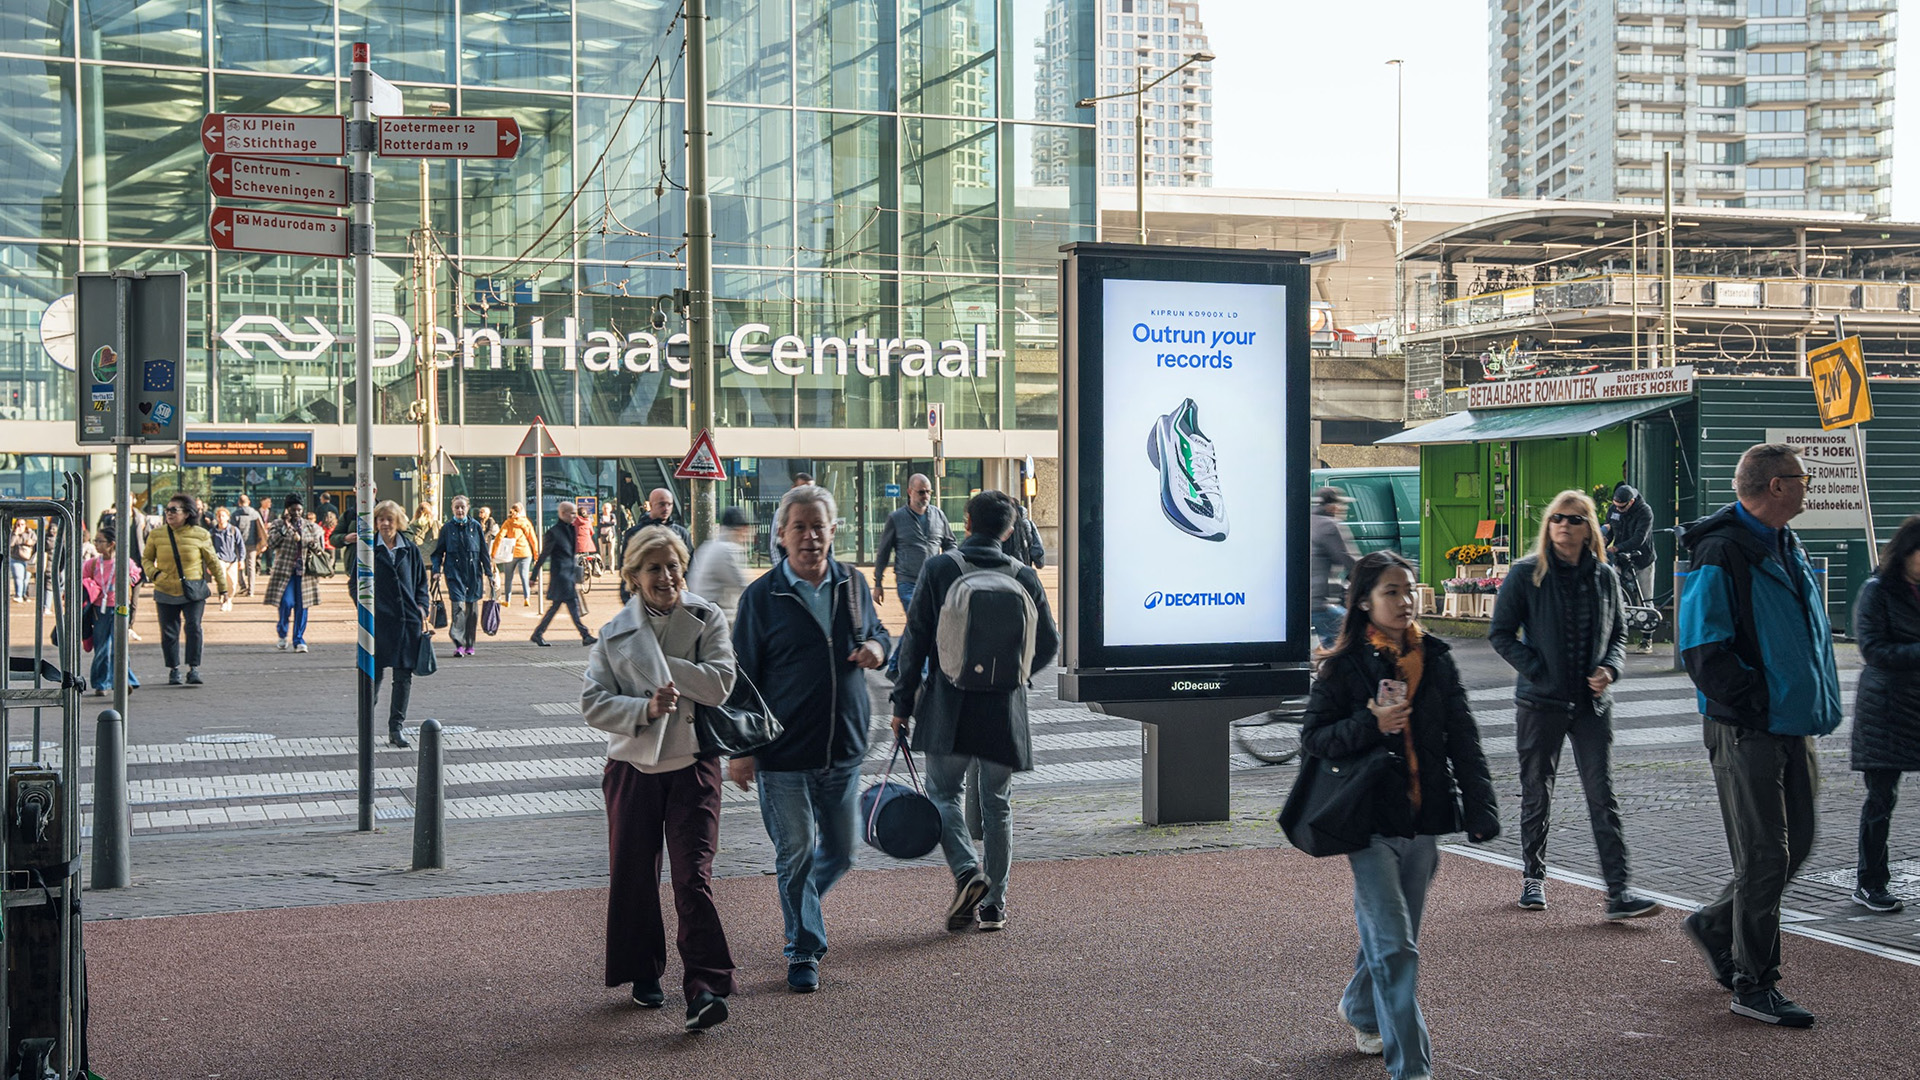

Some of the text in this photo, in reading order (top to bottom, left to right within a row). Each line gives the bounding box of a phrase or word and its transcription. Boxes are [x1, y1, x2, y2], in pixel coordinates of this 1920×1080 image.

[243, 120, 295, 131] KJ Plein
[384, 122, 475, 133] Zoetermeer 12
[243, 137, 317, 151] Stichthage
[384, 139, 468, 150] Rotterdam 19
[234, 162, 290, 177] Centrum
[234, 180, 335, 199] Scheveningen 2
[252, 215, 336, 232] Madurodam 3
[1150, 309, 1185, 317] KIPRUN
[1132, 323, 1256, 348] Outrun your
[372, 313, 988, 389] Den Haag Centraal
[1157, 350, 1233, 369] records
[1617, 370, 1674, 384] BLOEMENKIOSK
[1470, 377, 1598, 406] BETAALBARE ROMANTIEK
[1602, 379, 1688, 397] HENKIE'S HOEKIE
[1701, 428, 1707, 439] 4
[1786, 436, 1846, 444] BLOEMENKIOSK
[1823, 447, 1855, 457] HOEKI
[1819, 467, 1858, 479] ROMANTIE
[1165, 592, 1245, 606] DECATHLON
[1171, 681, 1220, 691] JCDecaux
